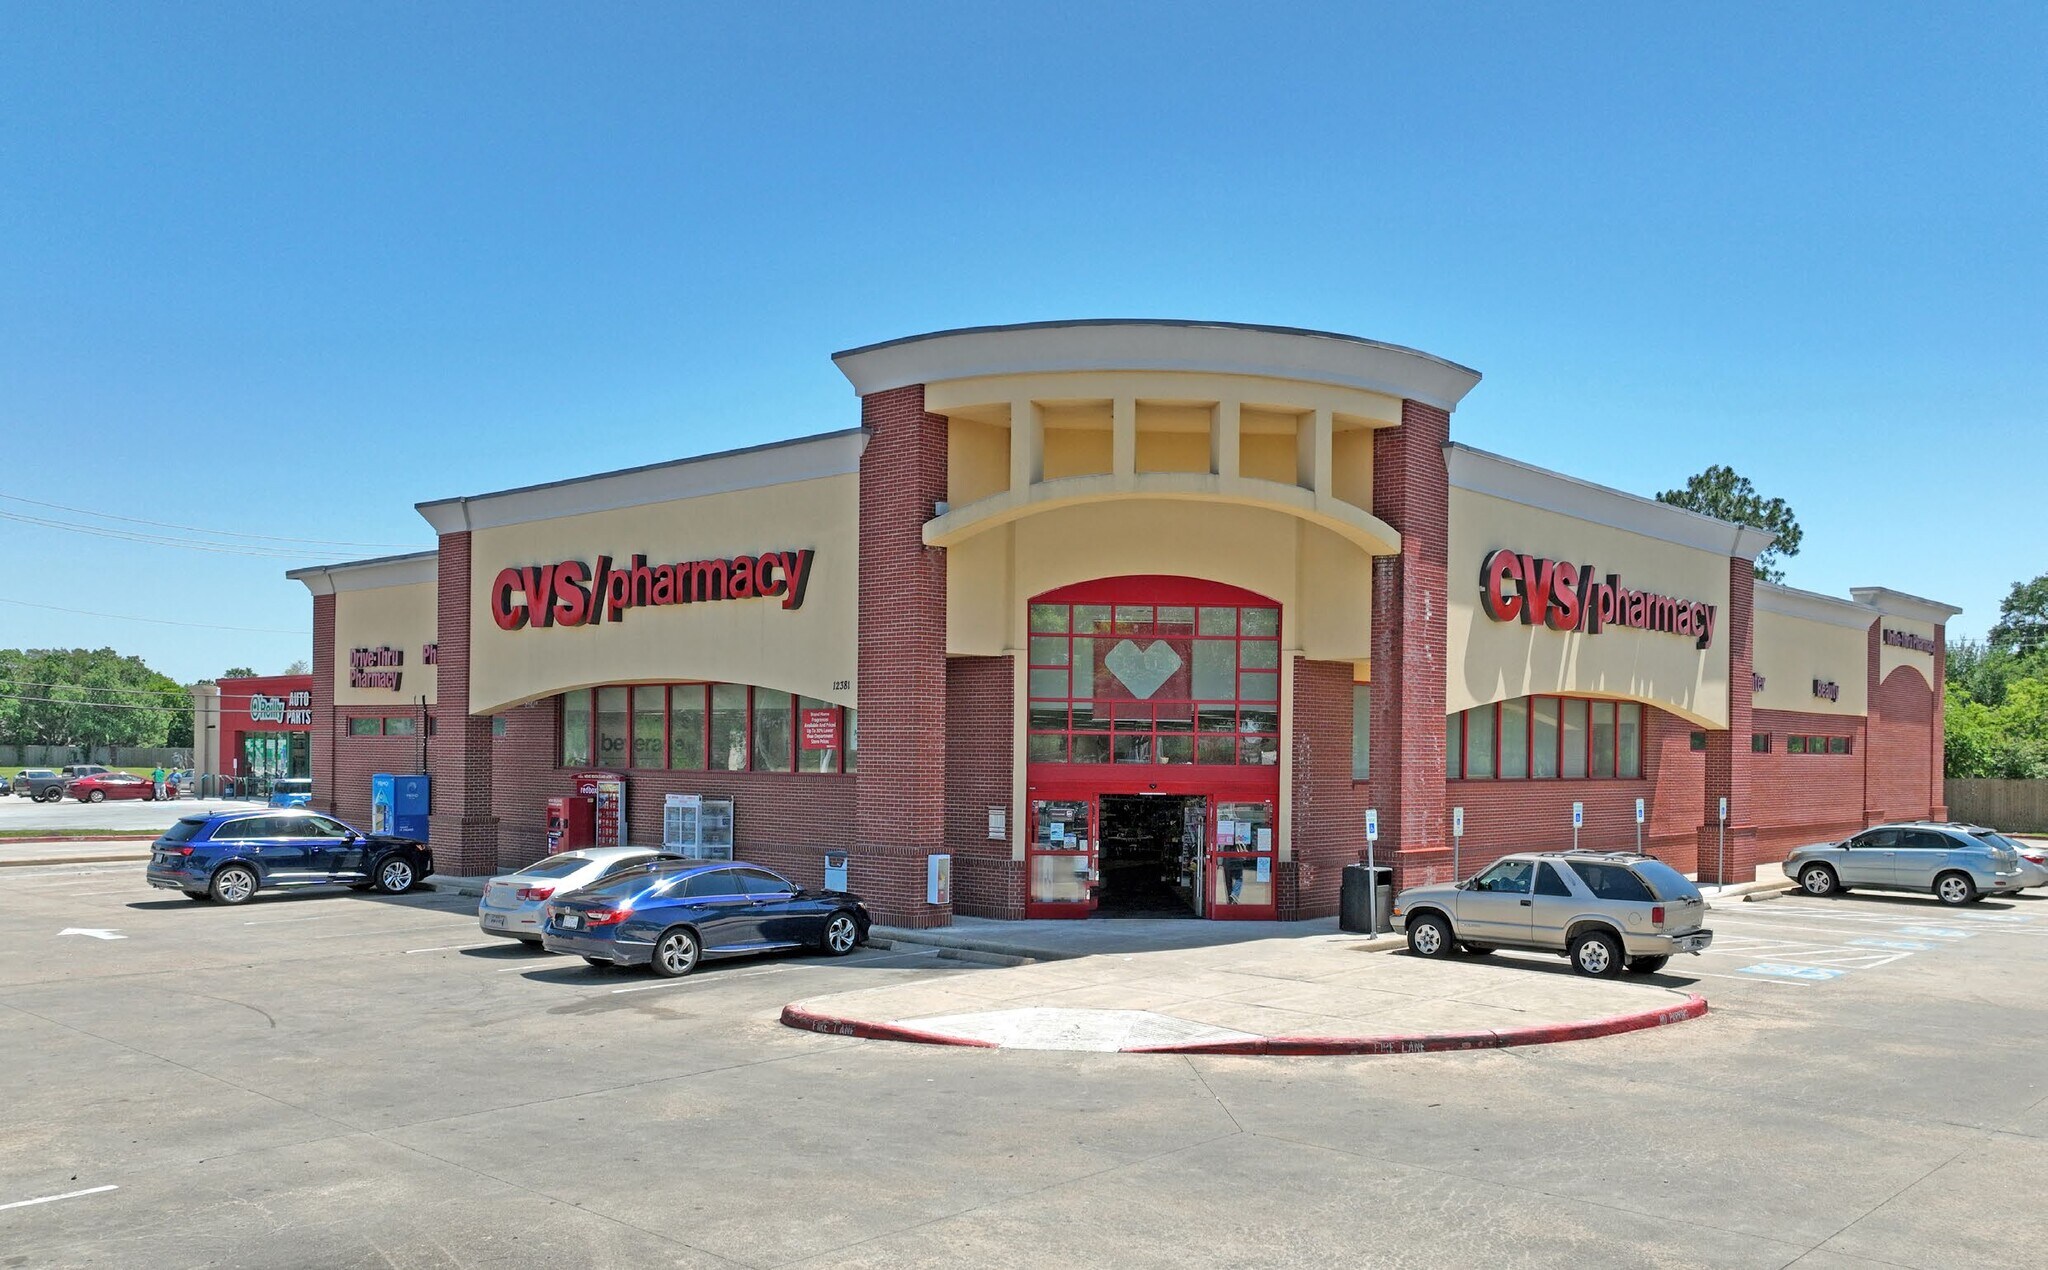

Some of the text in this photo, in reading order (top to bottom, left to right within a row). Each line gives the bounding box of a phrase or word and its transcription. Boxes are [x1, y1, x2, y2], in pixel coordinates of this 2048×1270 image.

[492, 550, 814, 631] CVS/pharmacy
[1479, 549, 1717, 650] CVS/pharmacy
[350, 647, 403, 667] Drive-Thru
[423, 645, 438, 664] Ph
[350, 669, 402, 691] Pharmacy
[833, 680, 850, 690] 12381
[289, 691, 310, 706] AUTO
[251, 694, 285, 723] O'Reilly
[287, 709, 312, 724] PARTS
[601, 733, 684, 752] beerae
